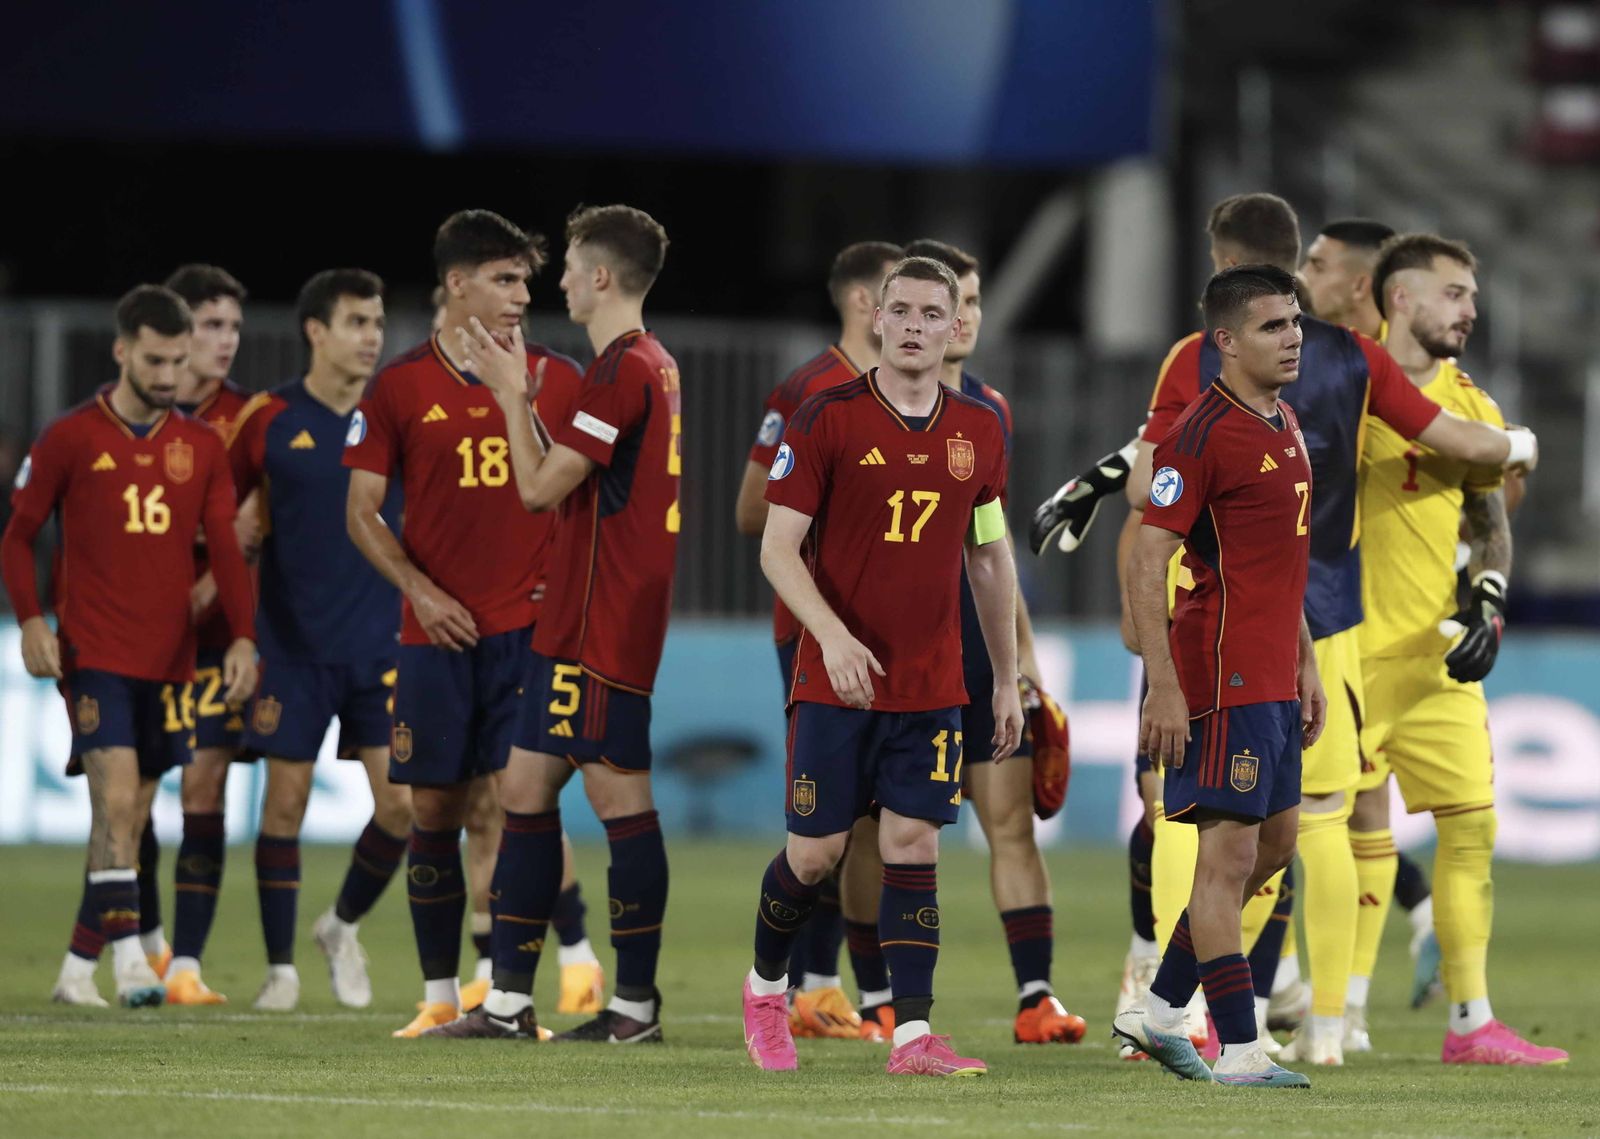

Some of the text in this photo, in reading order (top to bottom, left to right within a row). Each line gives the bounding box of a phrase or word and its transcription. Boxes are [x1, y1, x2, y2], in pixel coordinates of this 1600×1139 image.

[457, 436, 510, 488] 18
[1401, 446, 1420, 493] 1
[123, 483, 172, 536] 16
[884, 489, 941, 543] 17
[1294, 482, 1309, 537] 2
[549, 663, 583, 717] 5
